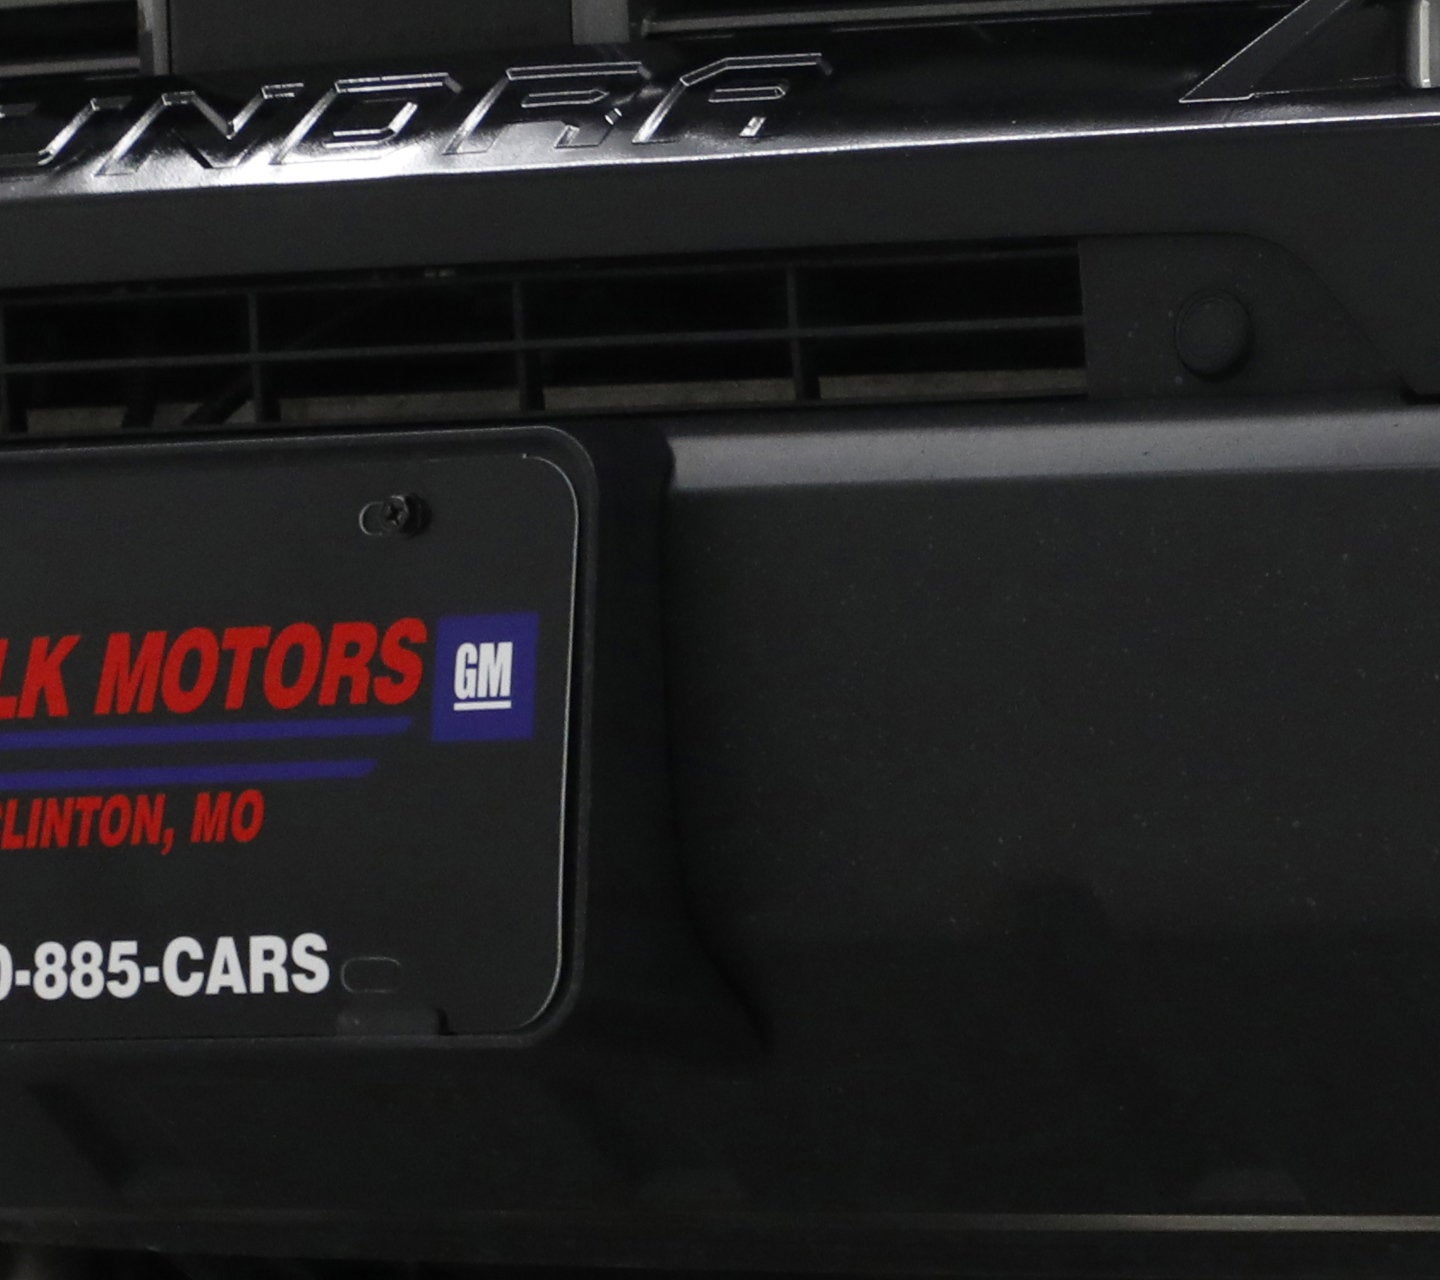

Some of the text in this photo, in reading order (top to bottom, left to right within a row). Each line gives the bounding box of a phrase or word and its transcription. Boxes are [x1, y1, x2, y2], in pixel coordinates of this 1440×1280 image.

[94, 618, 429, 715] MOTORS
[453, 641, 513, 700] GM
[191, 790, 264, 843] MO
